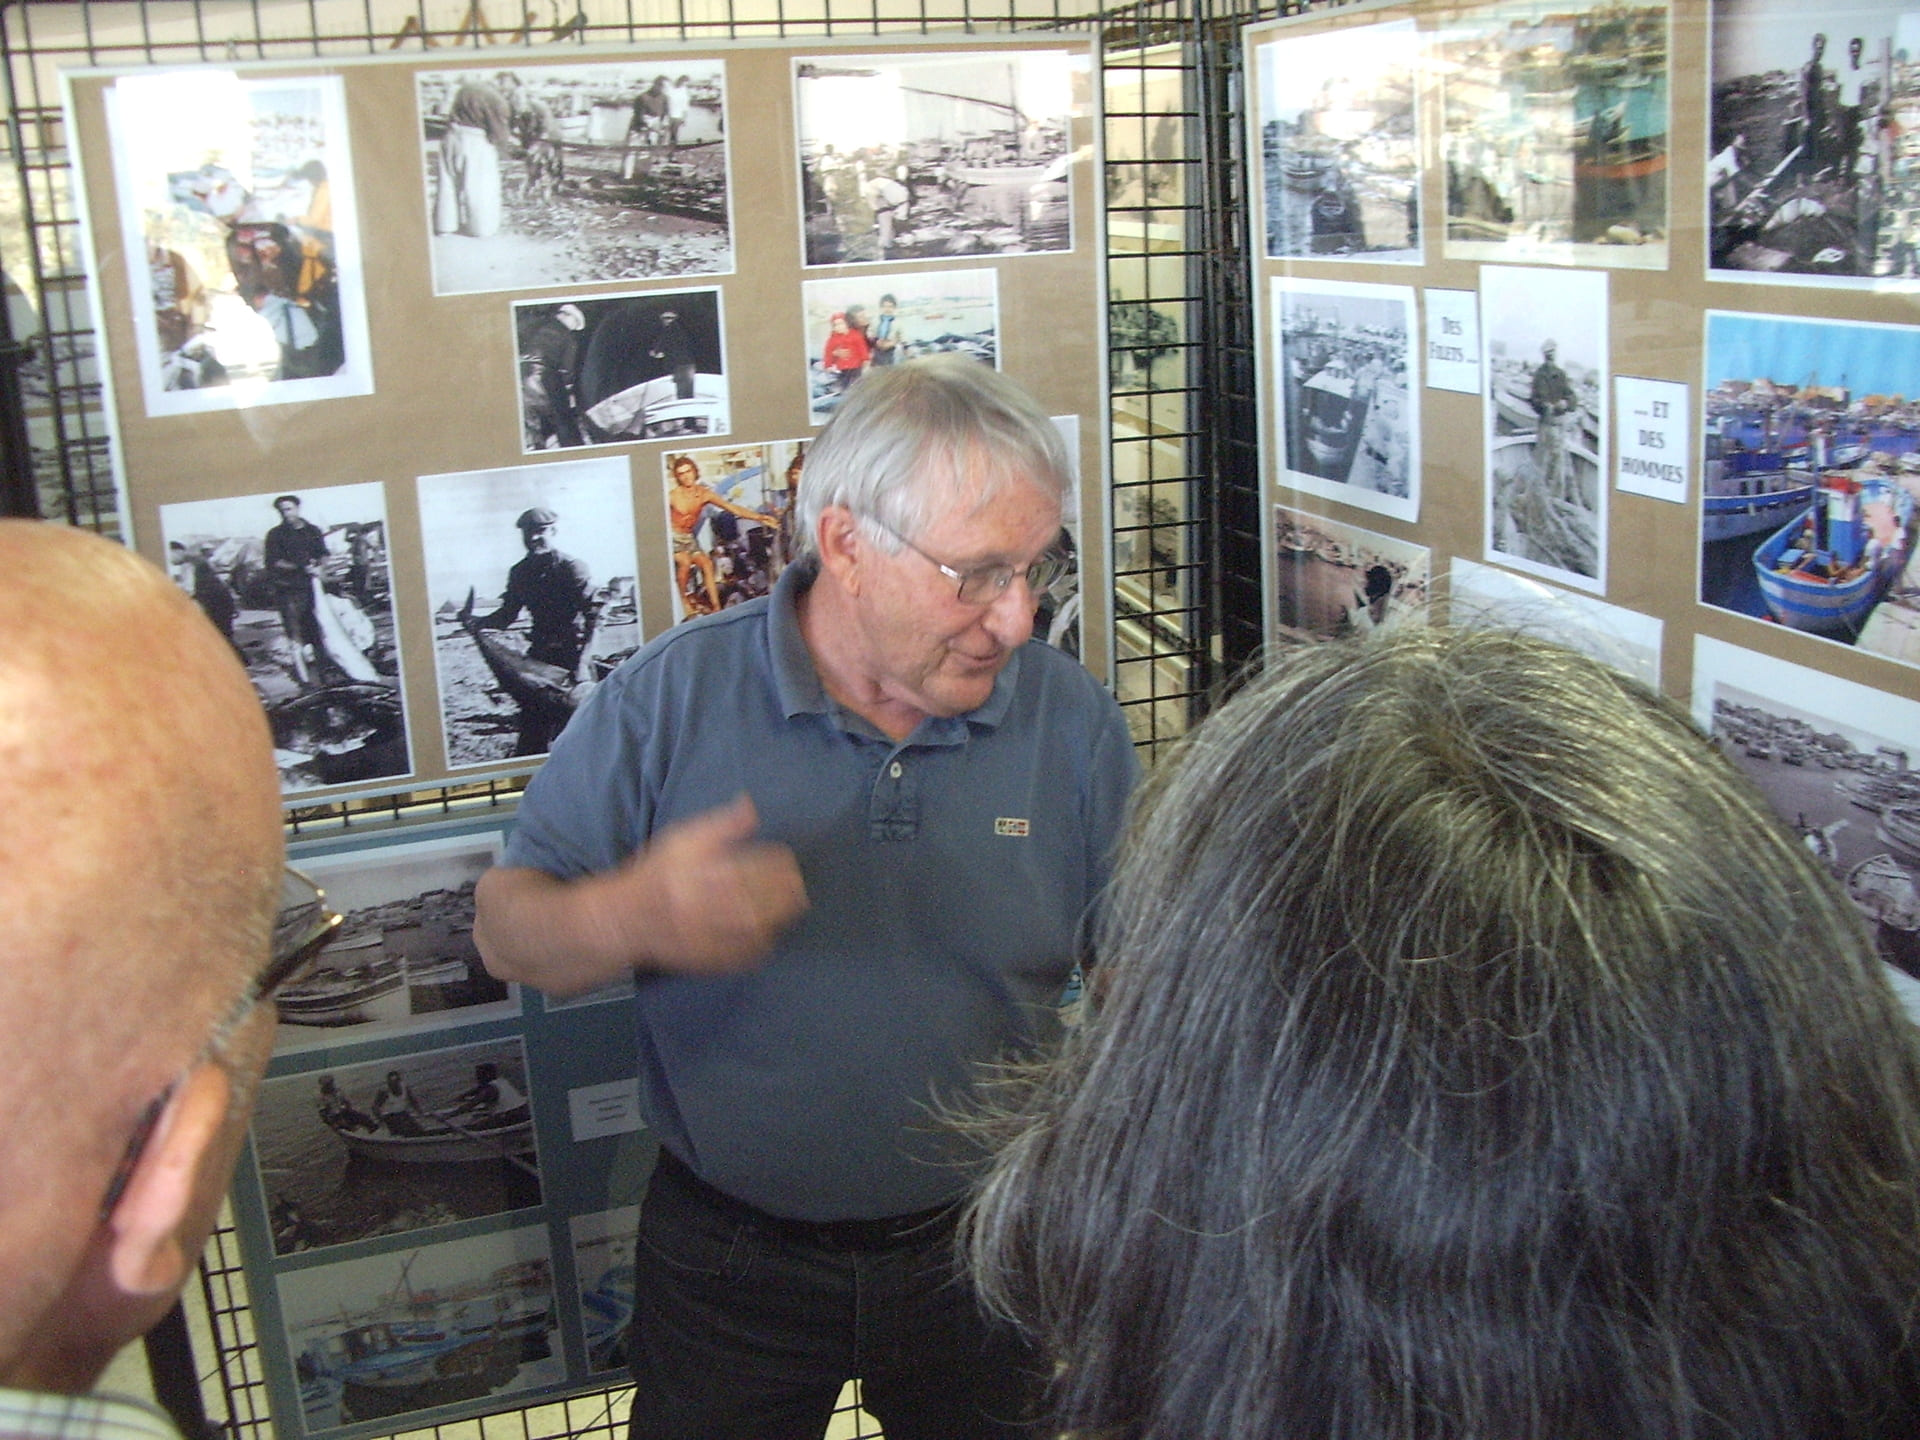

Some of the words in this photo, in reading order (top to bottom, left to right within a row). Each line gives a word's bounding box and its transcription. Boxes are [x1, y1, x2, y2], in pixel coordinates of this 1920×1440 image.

[1652, 401, 1669, 418] ET
[1639, 430, 1665, 448] DES
[1621, 457, 1684, 483] HOMMES
